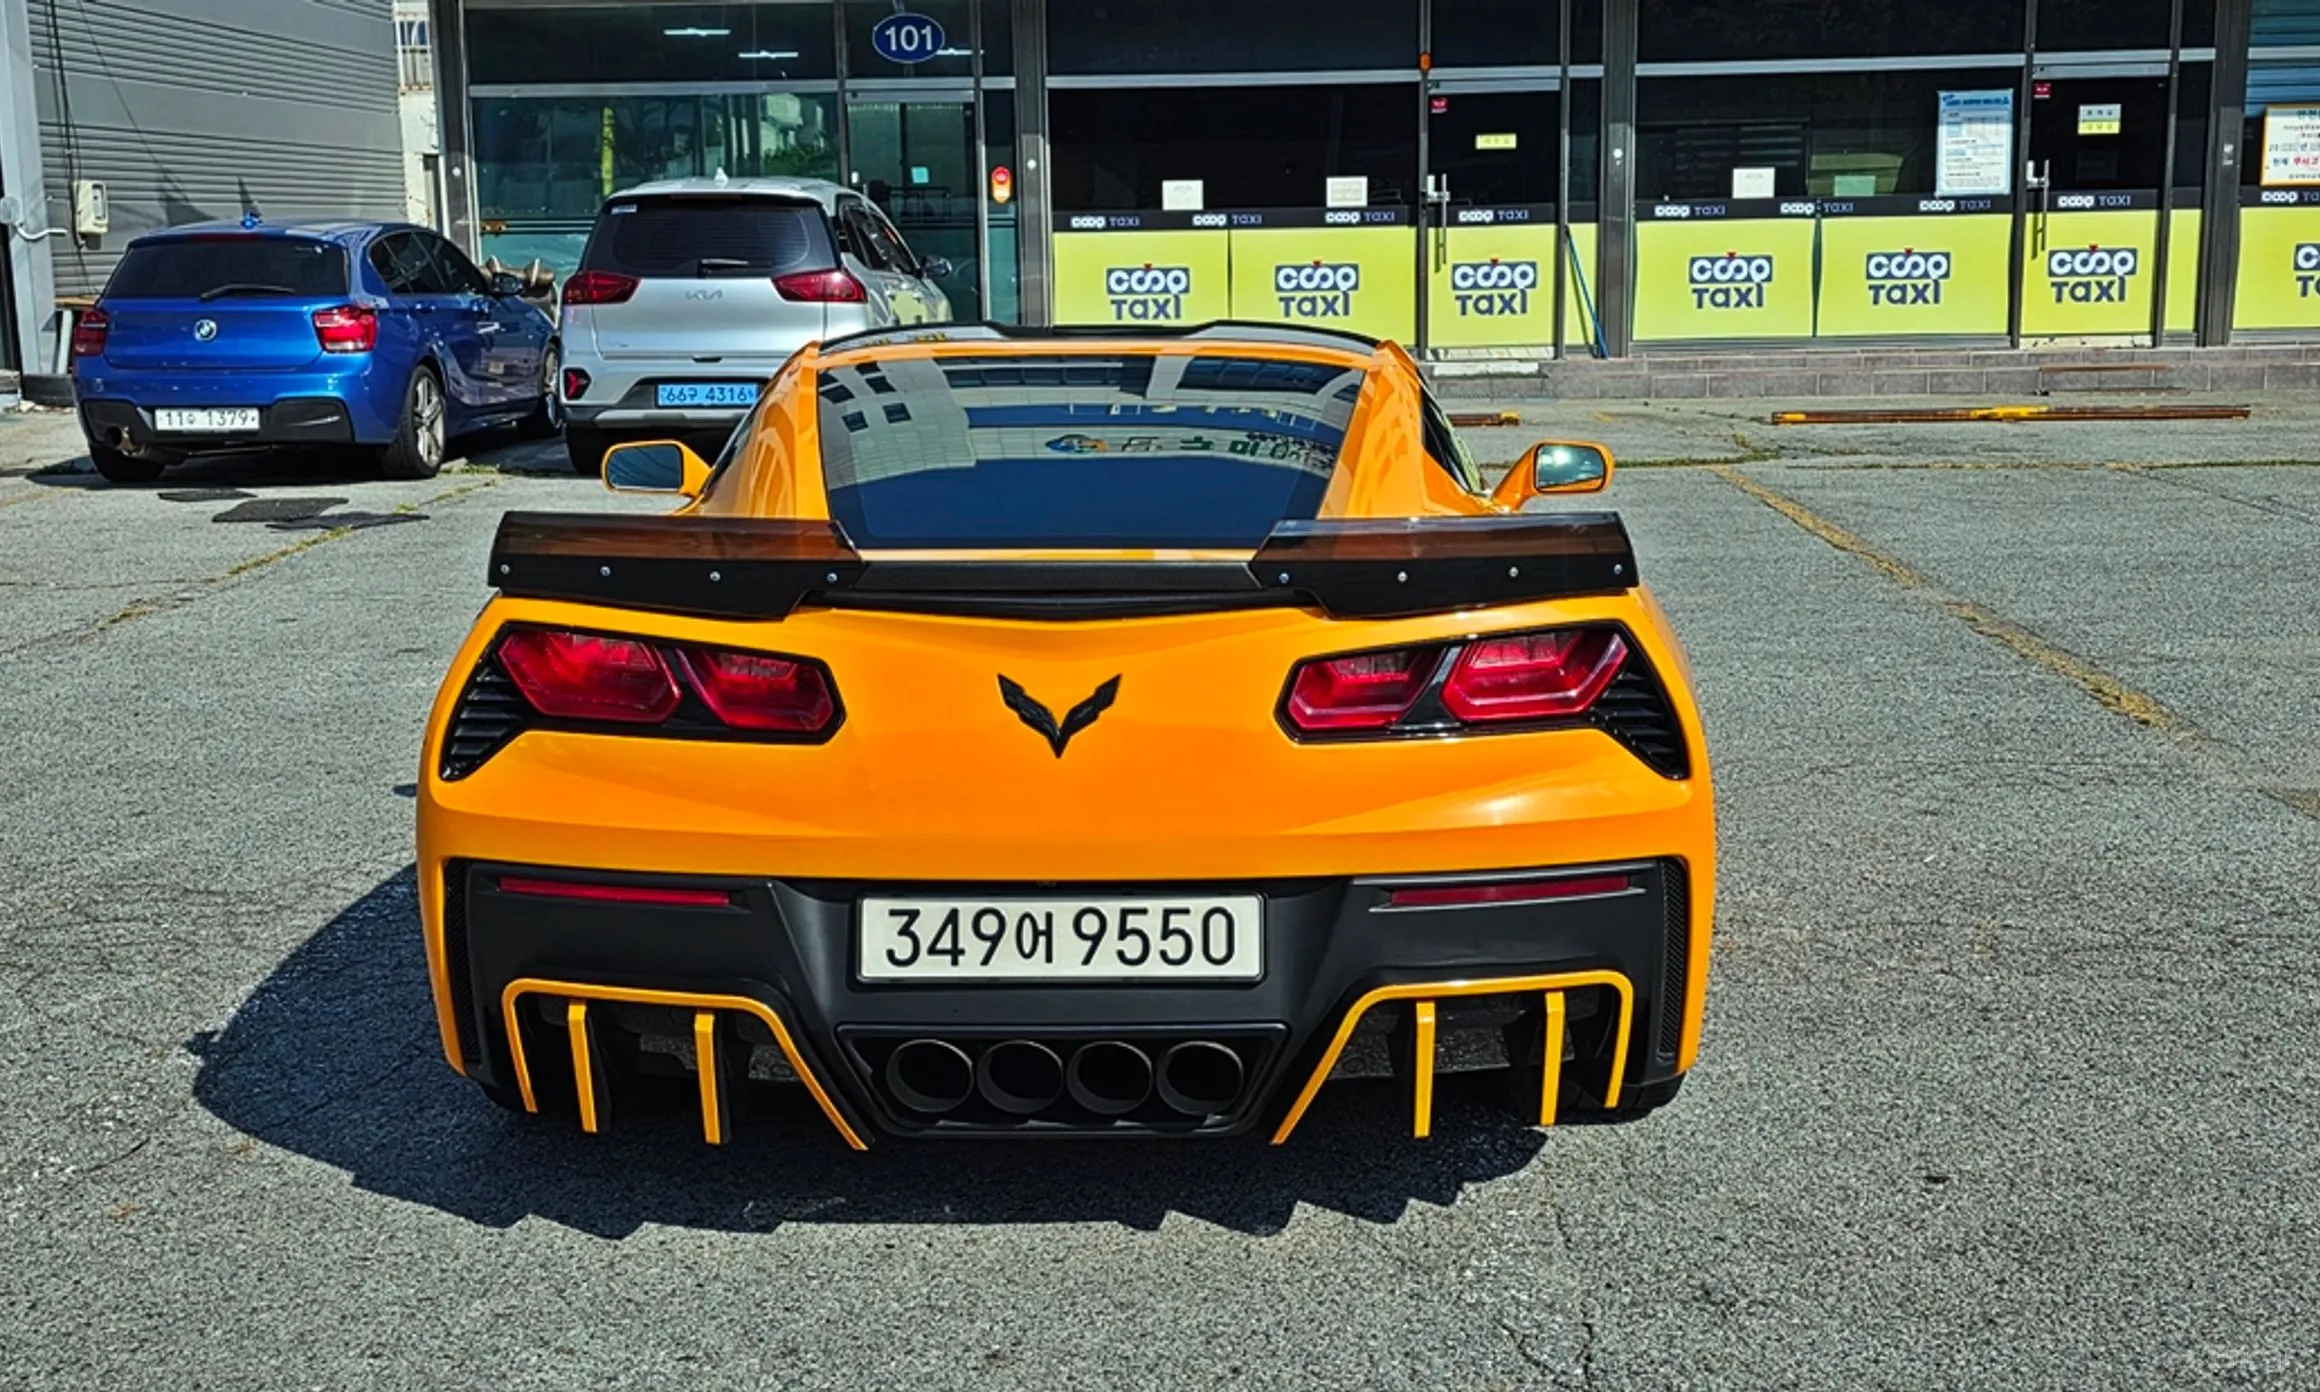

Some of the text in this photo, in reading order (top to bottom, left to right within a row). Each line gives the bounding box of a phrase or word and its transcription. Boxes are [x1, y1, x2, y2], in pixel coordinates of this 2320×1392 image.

[885, 24, 933, 52] 101
[1691, 257, 1771, 283] coop
[1868, 253, 1949, 280] coop
[2050, 250, 2136, 276] coop
[1107, 267, 1189, 295] coop
[1276, 265, 1358, 292] coop
[1453, 264, 1536, 289] coop
[704, 386, 748, 402] 4316
[207, 409, 248, 427] 1379
[885, 906, 1236, 968] 349어 9550
